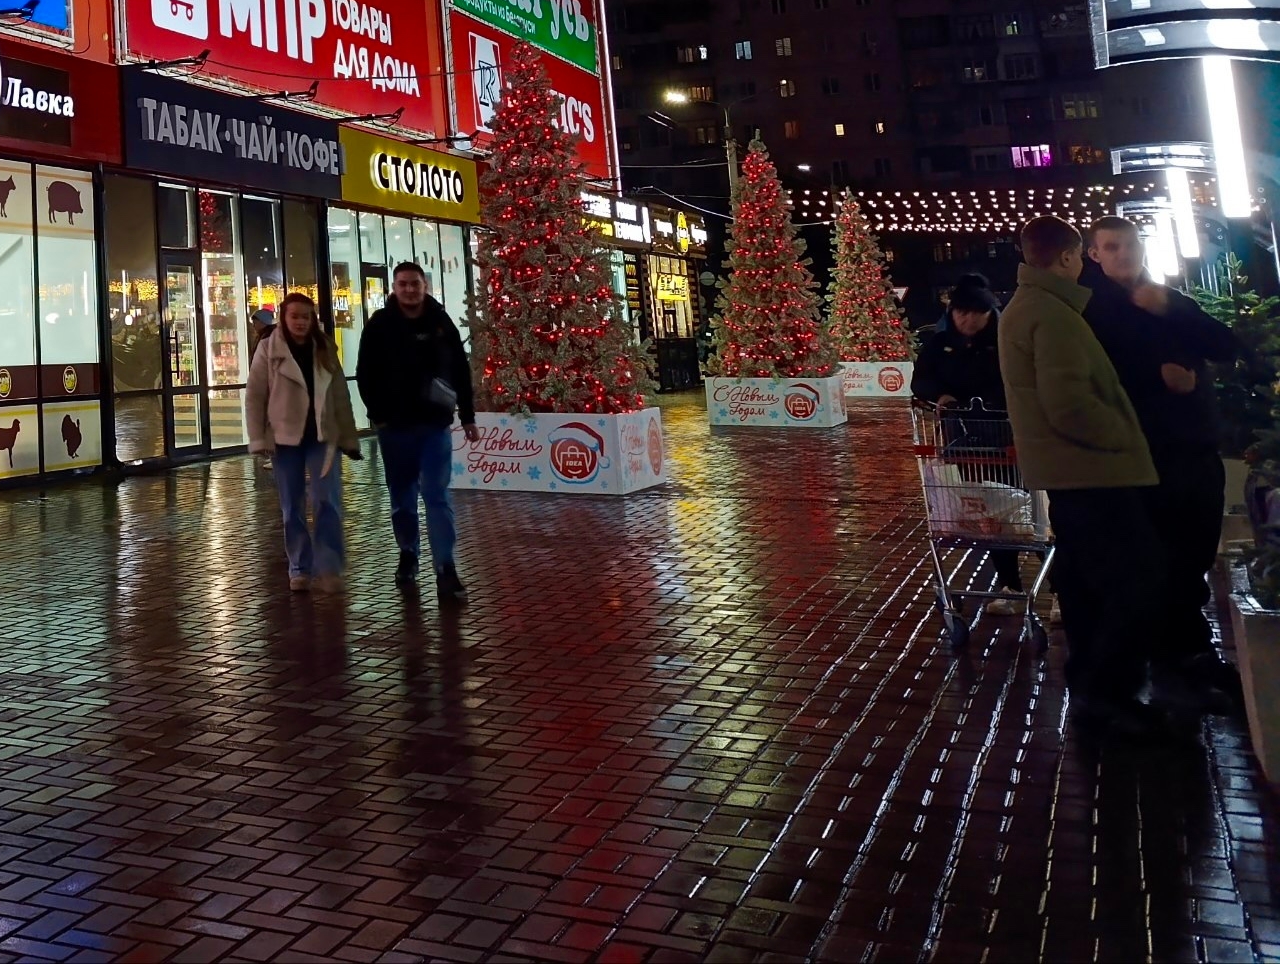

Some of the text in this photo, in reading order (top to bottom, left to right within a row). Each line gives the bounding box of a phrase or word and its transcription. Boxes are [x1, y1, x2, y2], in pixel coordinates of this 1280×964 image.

[333, 38, 420, 98] ДЛЯ ДОМА
[2, 77, 75, 118] Лавка
[373, 152, 465, 205] СТОЛОТО
